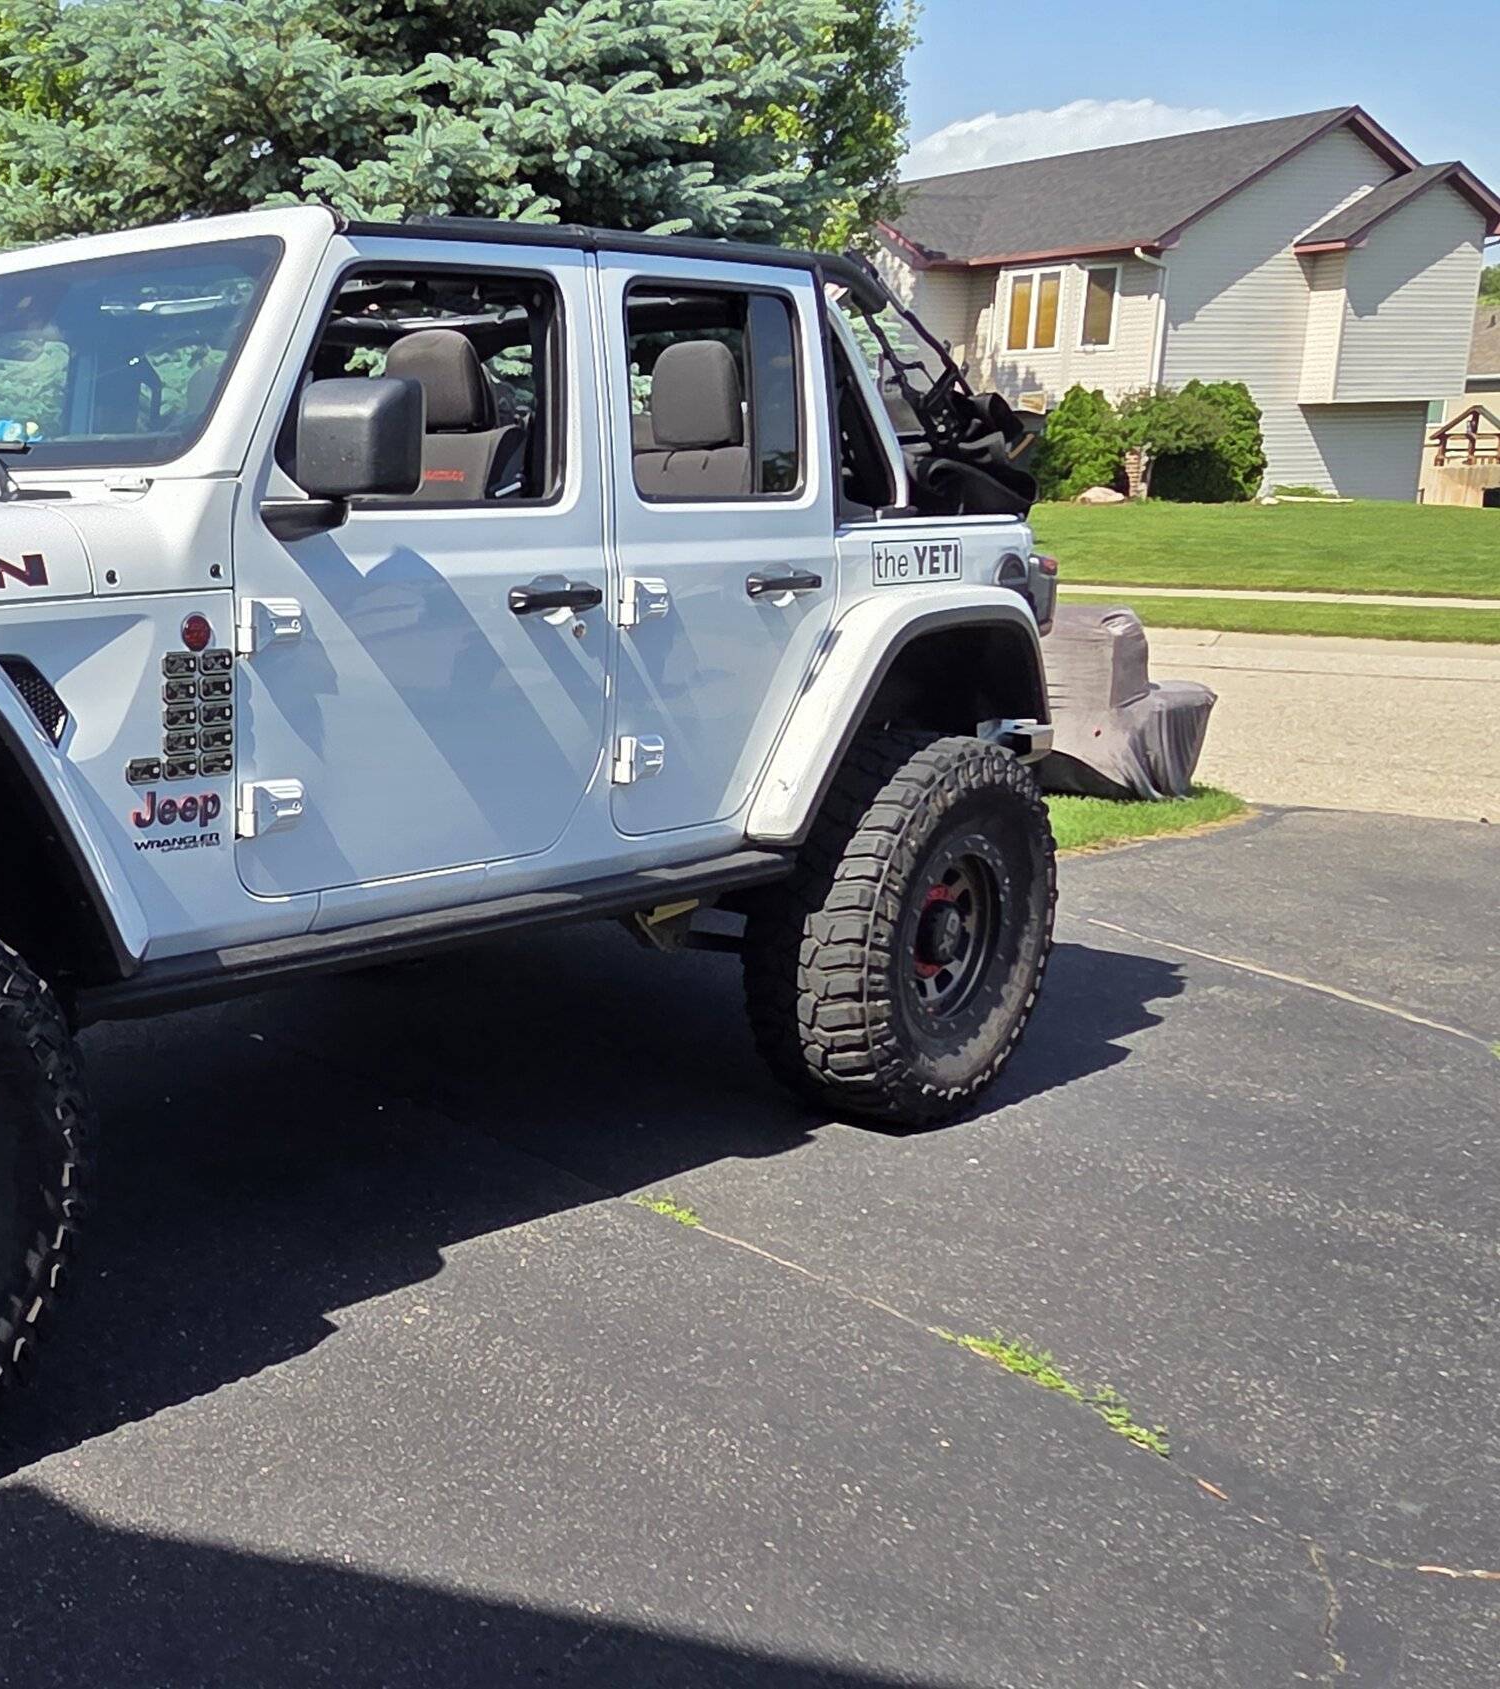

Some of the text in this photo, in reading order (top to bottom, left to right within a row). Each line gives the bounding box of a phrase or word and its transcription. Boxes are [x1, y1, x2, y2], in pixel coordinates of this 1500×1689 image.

[875, 544, 959, 578] the YETI
[132, 791, 221, 828] Jeep
[134, 832, 220, 851] WRANGLER
